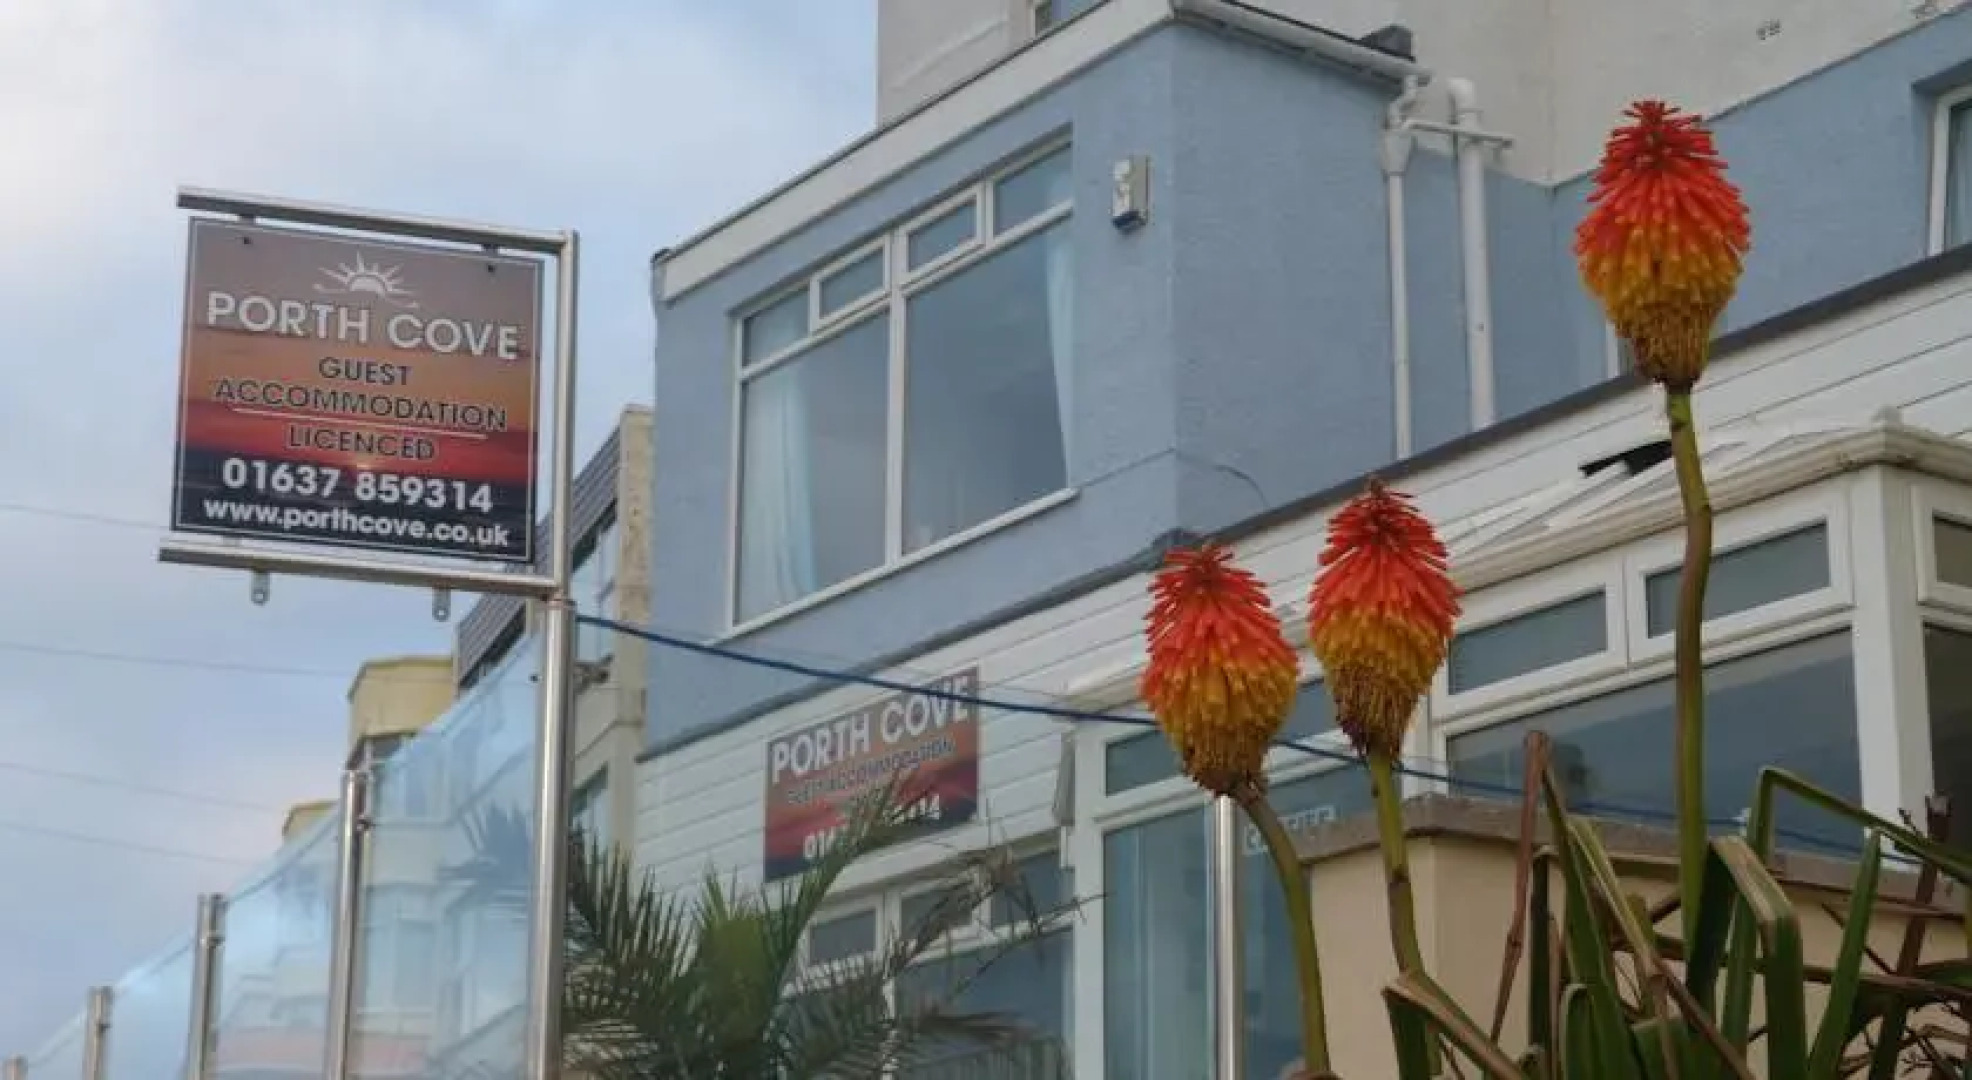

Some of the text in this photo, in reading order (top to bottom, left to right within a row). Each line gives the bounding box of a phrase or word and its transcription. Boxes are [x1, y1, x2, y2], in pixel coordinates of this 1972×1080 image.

[207, 291, 518, 360] PORTH COVE
[319, 356, 411, 386] GUEST
[215, 377, 507, 430] ACCOMMODATION
[289, 425, 435, 460] LICENCED
[222, 457, 493, 513] 01637 859314
[203, 499, 508, 547] www.porthcove.co.uk
[771, 675, 968, 784] PORTH COVE
